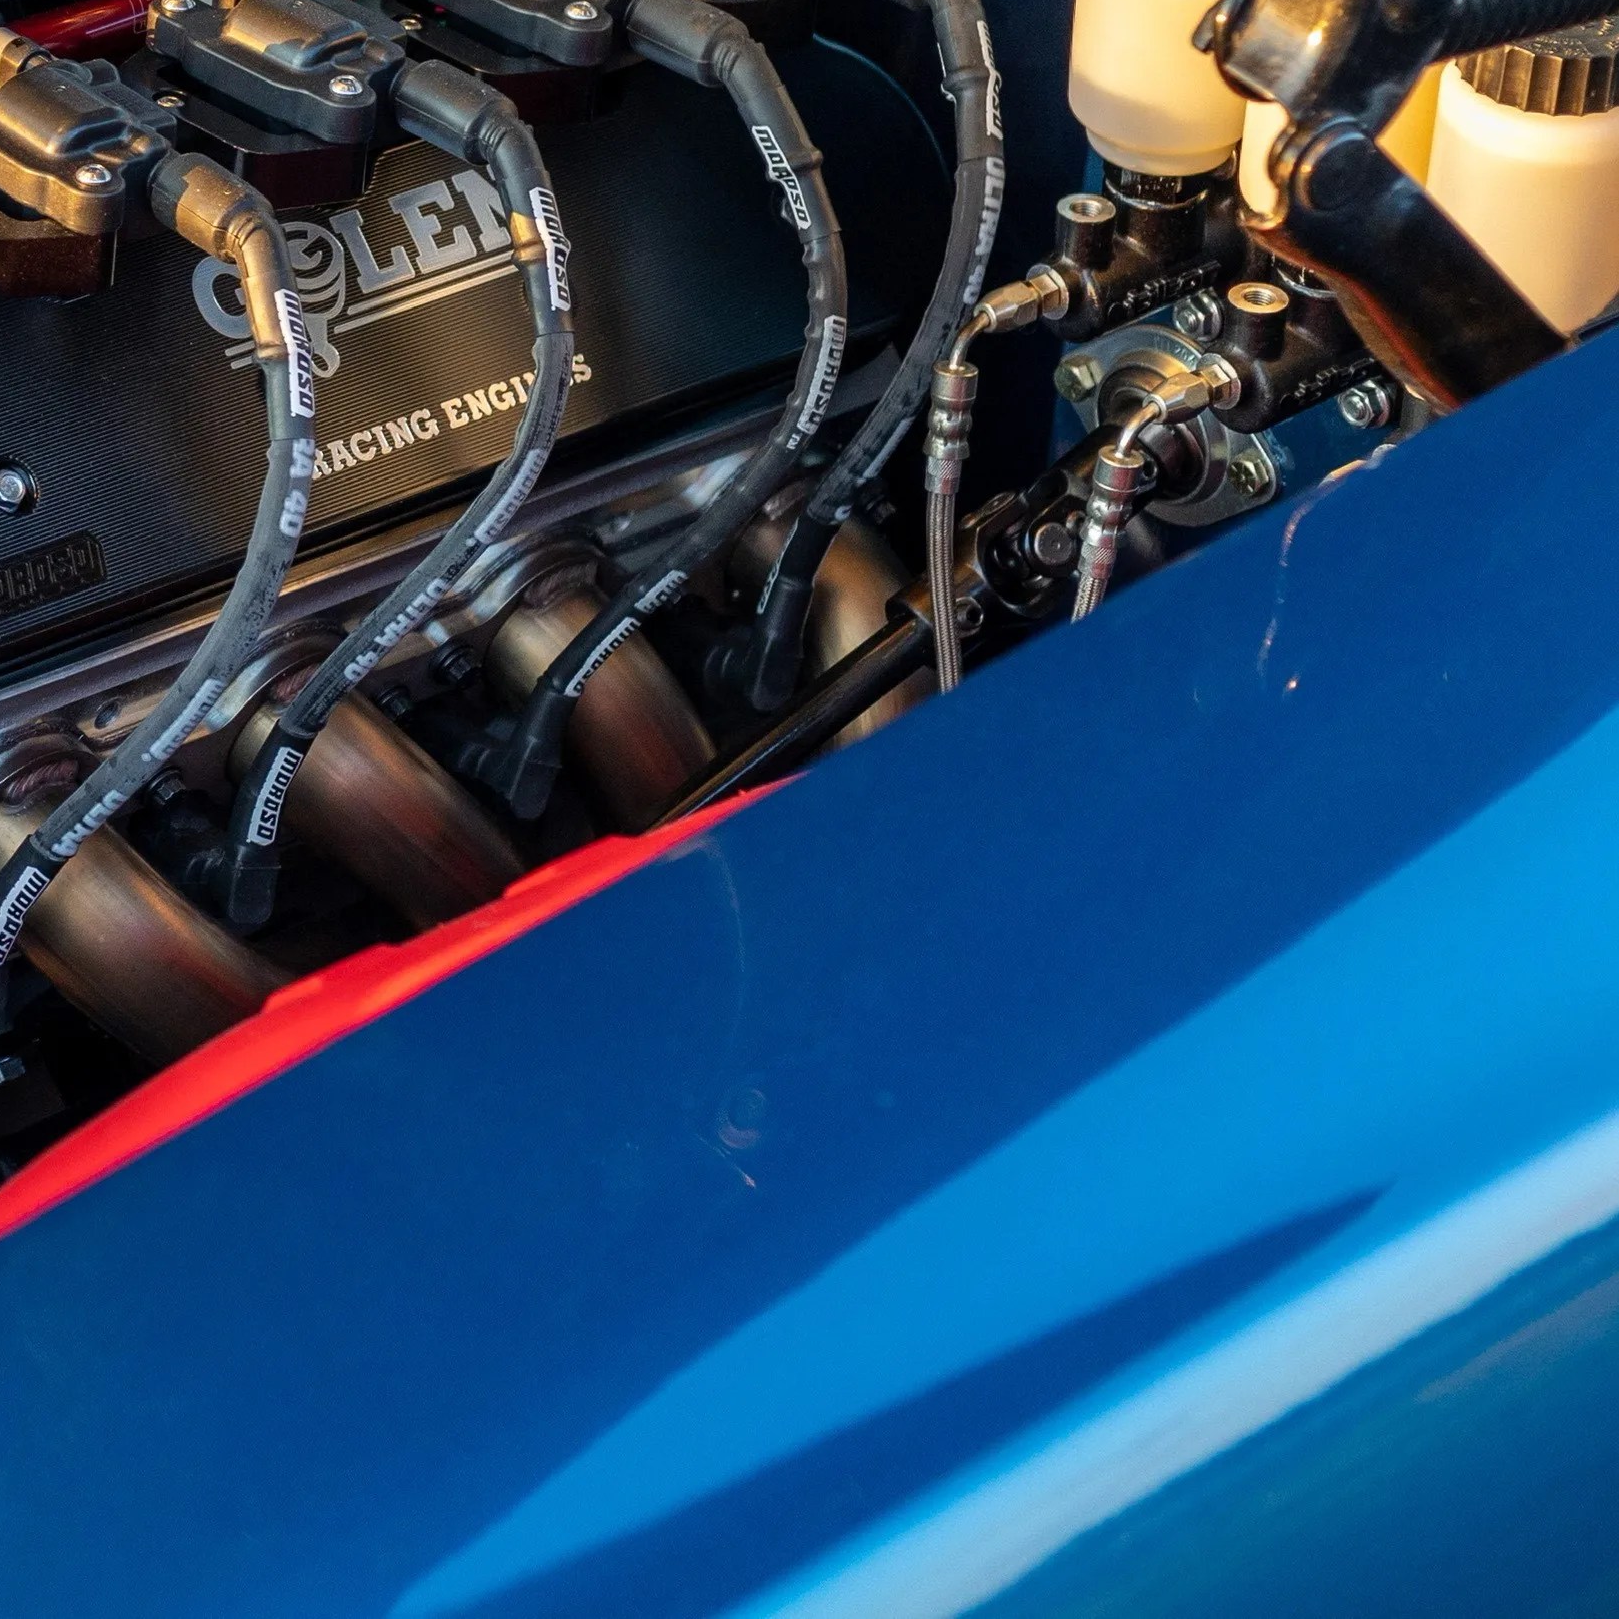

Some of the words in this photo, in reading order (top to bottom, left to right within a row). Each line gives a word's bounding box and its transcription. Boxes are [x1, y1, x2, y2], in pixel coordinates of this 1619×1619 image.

[753, 125, 812, 230] MOROSO
[533, 188, 572, 309] MOROSO
[279, 290, 315, 416] MOROSO
[312, 408, 440, 479] RACING
[439, 352, 593, 430] ENGIS
[374, 577, 448, 648] ULTRA
[247, 747, 305, 847] MOROSO
